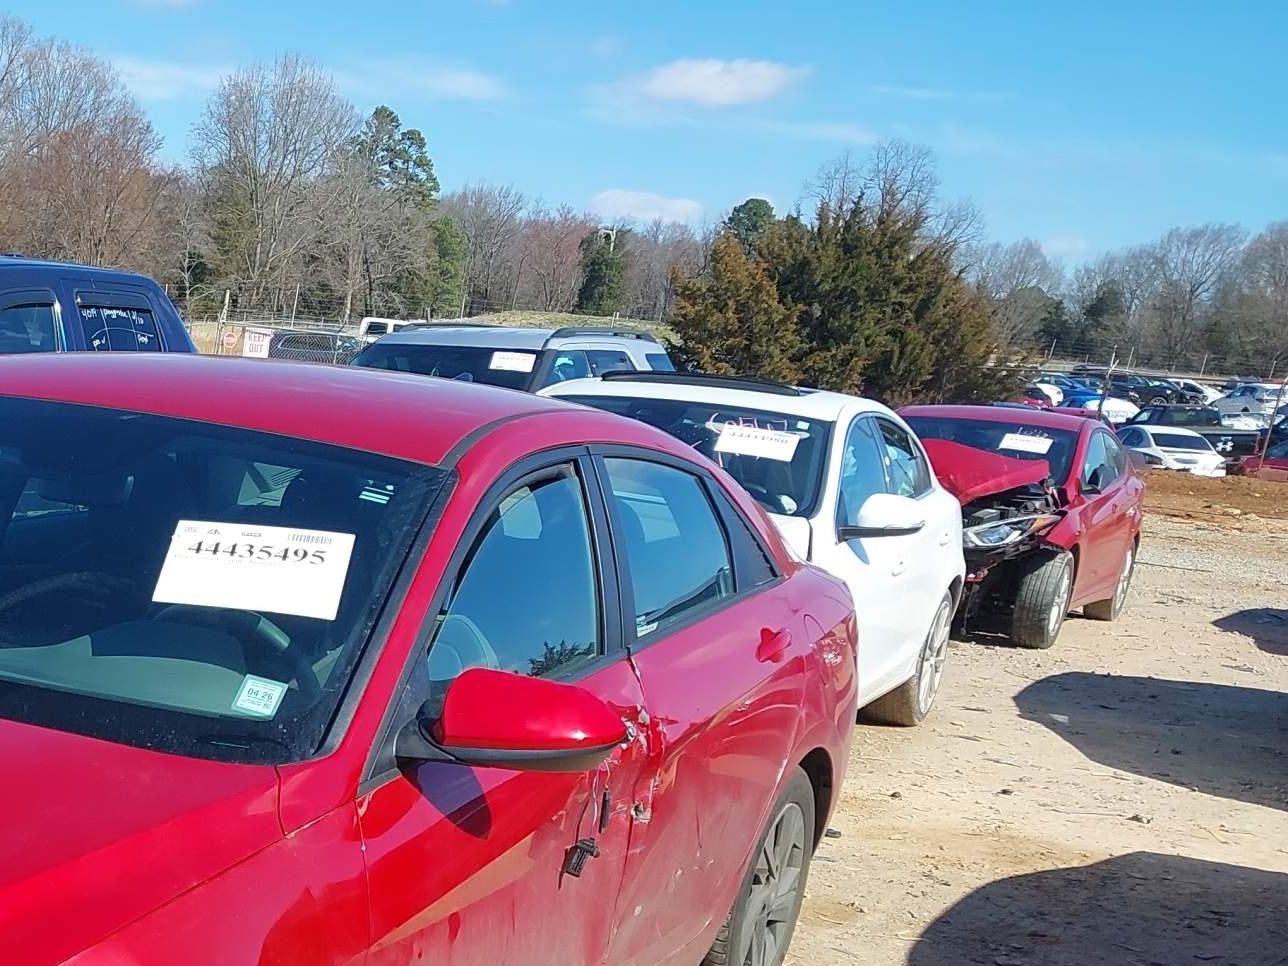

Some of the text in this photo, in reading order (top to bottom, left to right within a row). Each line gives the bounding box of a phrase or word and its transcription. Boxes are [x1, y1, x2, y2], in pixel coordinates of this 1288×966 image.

[249, 331, 266, 342] KEEP
[248, 343, 264, 353] OUT
[187, 540, 328, 565] 44435495
[261, 691, 273, 701] 26
